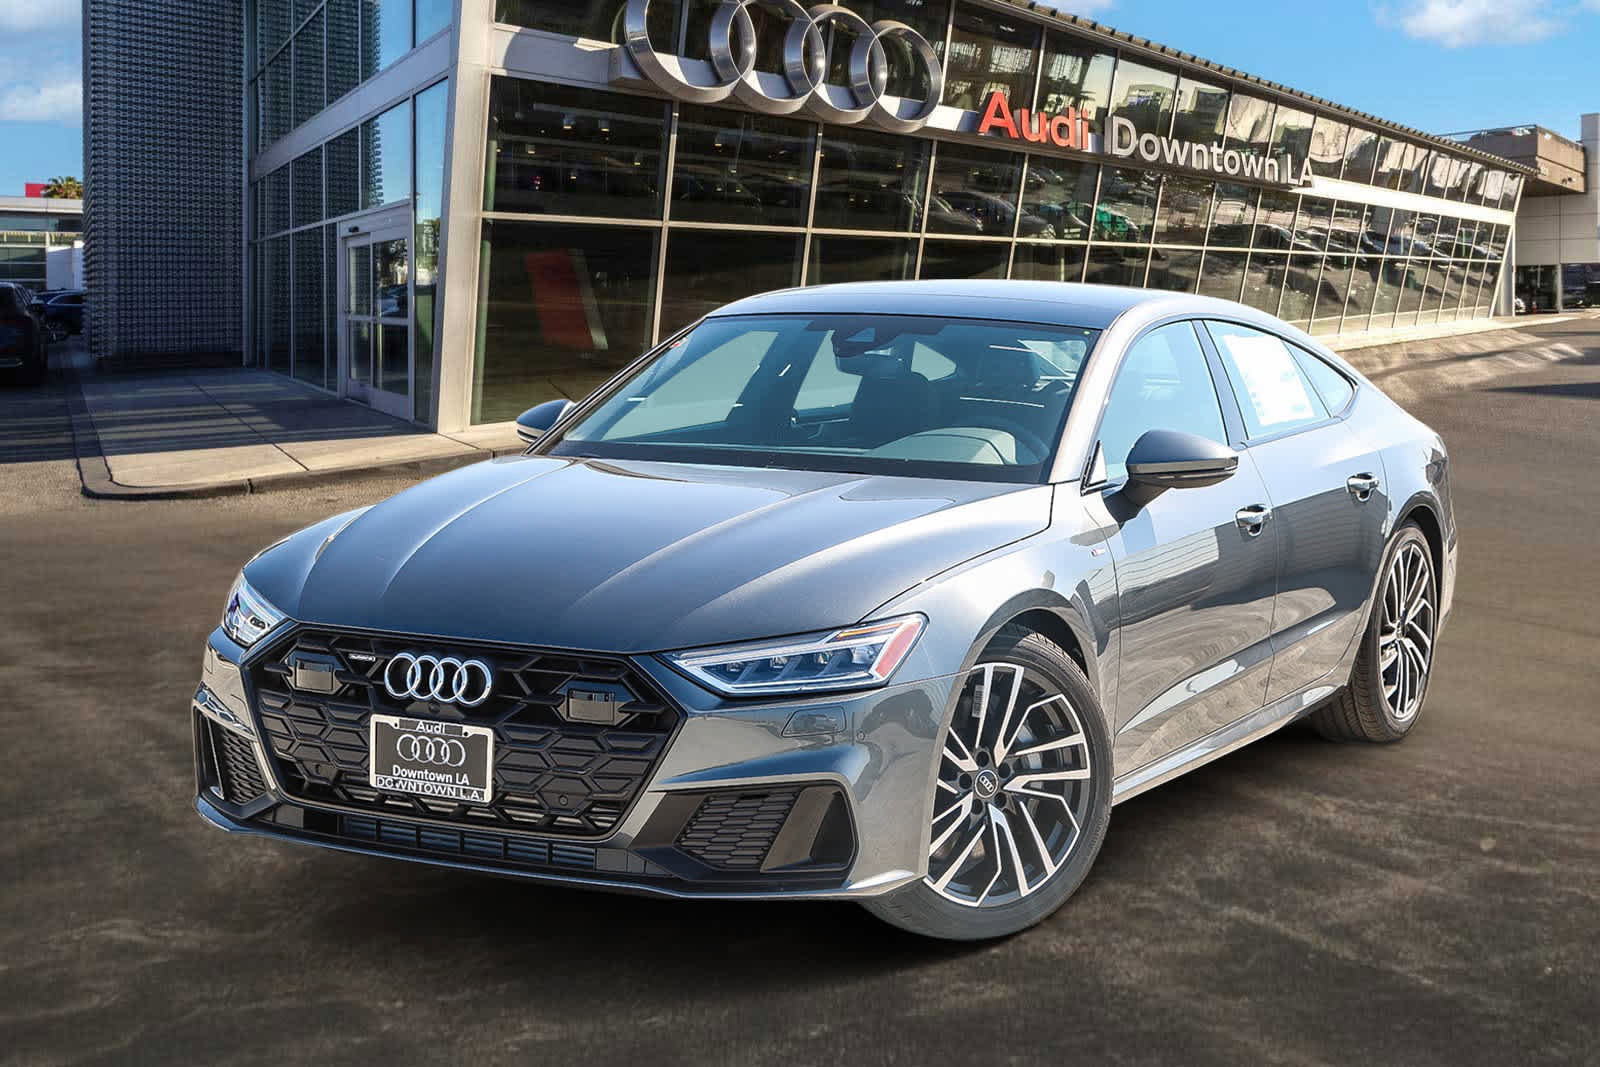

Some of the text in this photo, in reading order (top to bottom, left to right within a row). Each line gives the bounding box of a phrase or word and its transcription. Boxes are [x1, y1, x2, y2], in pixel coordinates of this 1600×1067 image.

[978, 91, 1314, 187] Audi Downtown LA
[416, 720, 446, 734] Audi
[392, 764, 470, 785] Downtown LA
